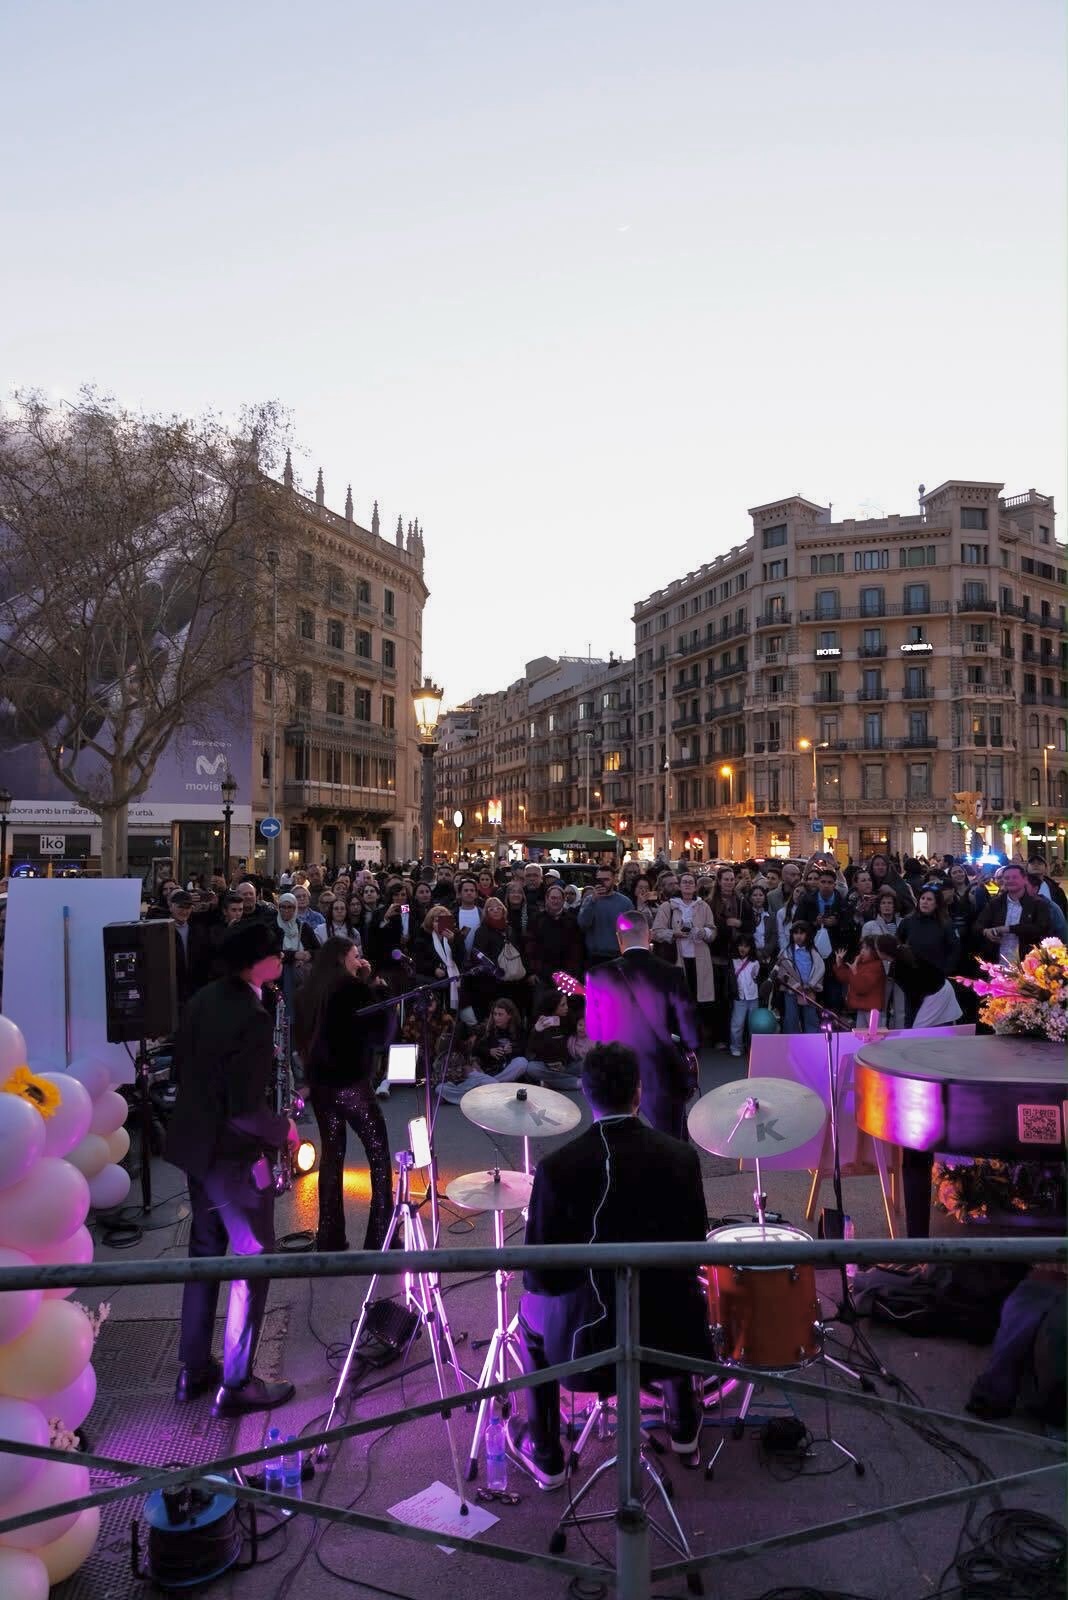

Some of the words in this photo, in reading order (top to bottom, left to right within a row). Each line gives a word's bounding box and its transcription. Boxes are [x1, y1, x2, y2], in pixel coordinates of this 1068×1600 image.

[816, 648, 841, 656] HOTEL
[185, 781, 223, 791] movist
[34, 807, 53, 815] amb
[54, 807, 61, 815] la
[62, 807, 88, 815] millora
[529, 1108, 563, 1127] K
[756, 1118, 786, 1142] K
